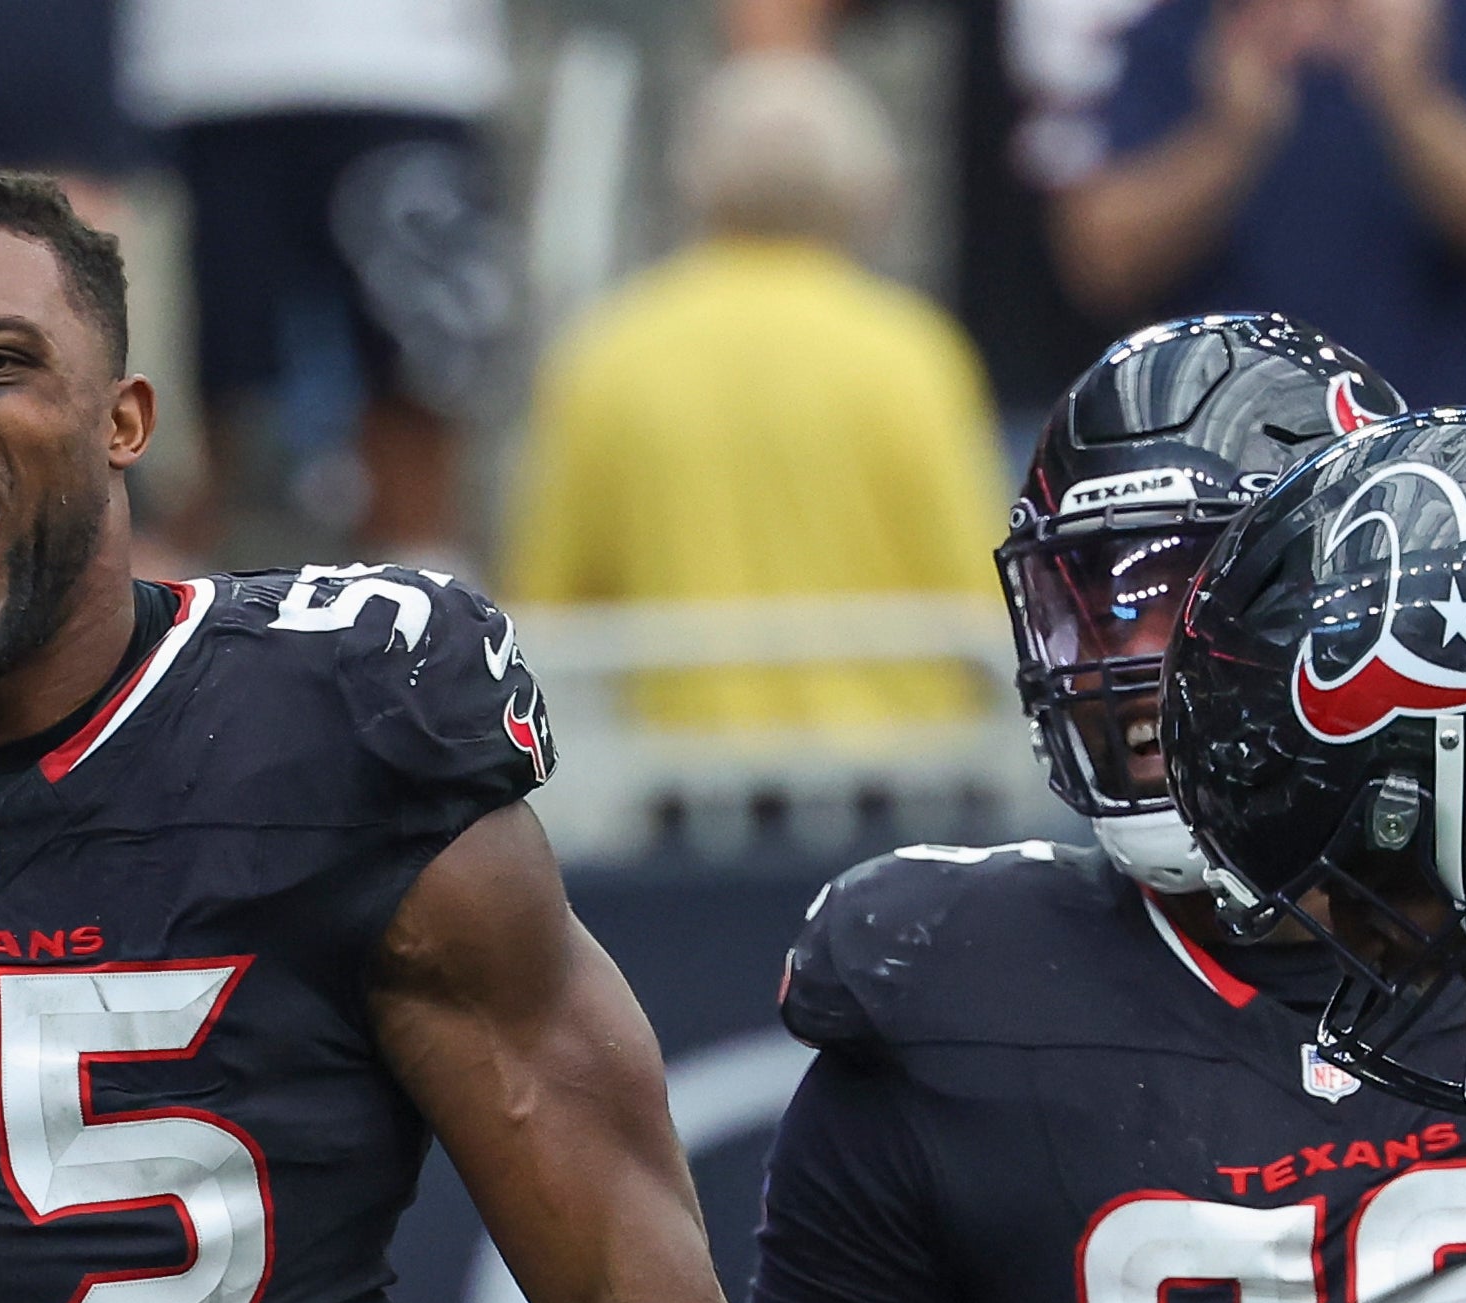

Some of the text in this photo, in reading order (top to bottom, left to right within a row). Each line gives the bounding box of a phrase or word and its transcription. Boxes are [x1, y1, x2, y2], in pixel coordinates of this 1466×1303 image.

[1072, 475, 1175, 504] TEXANS
[1314, 1063, 1356, 1090] NFL
[1216, 1121, 1461, 1196] TEXANS
